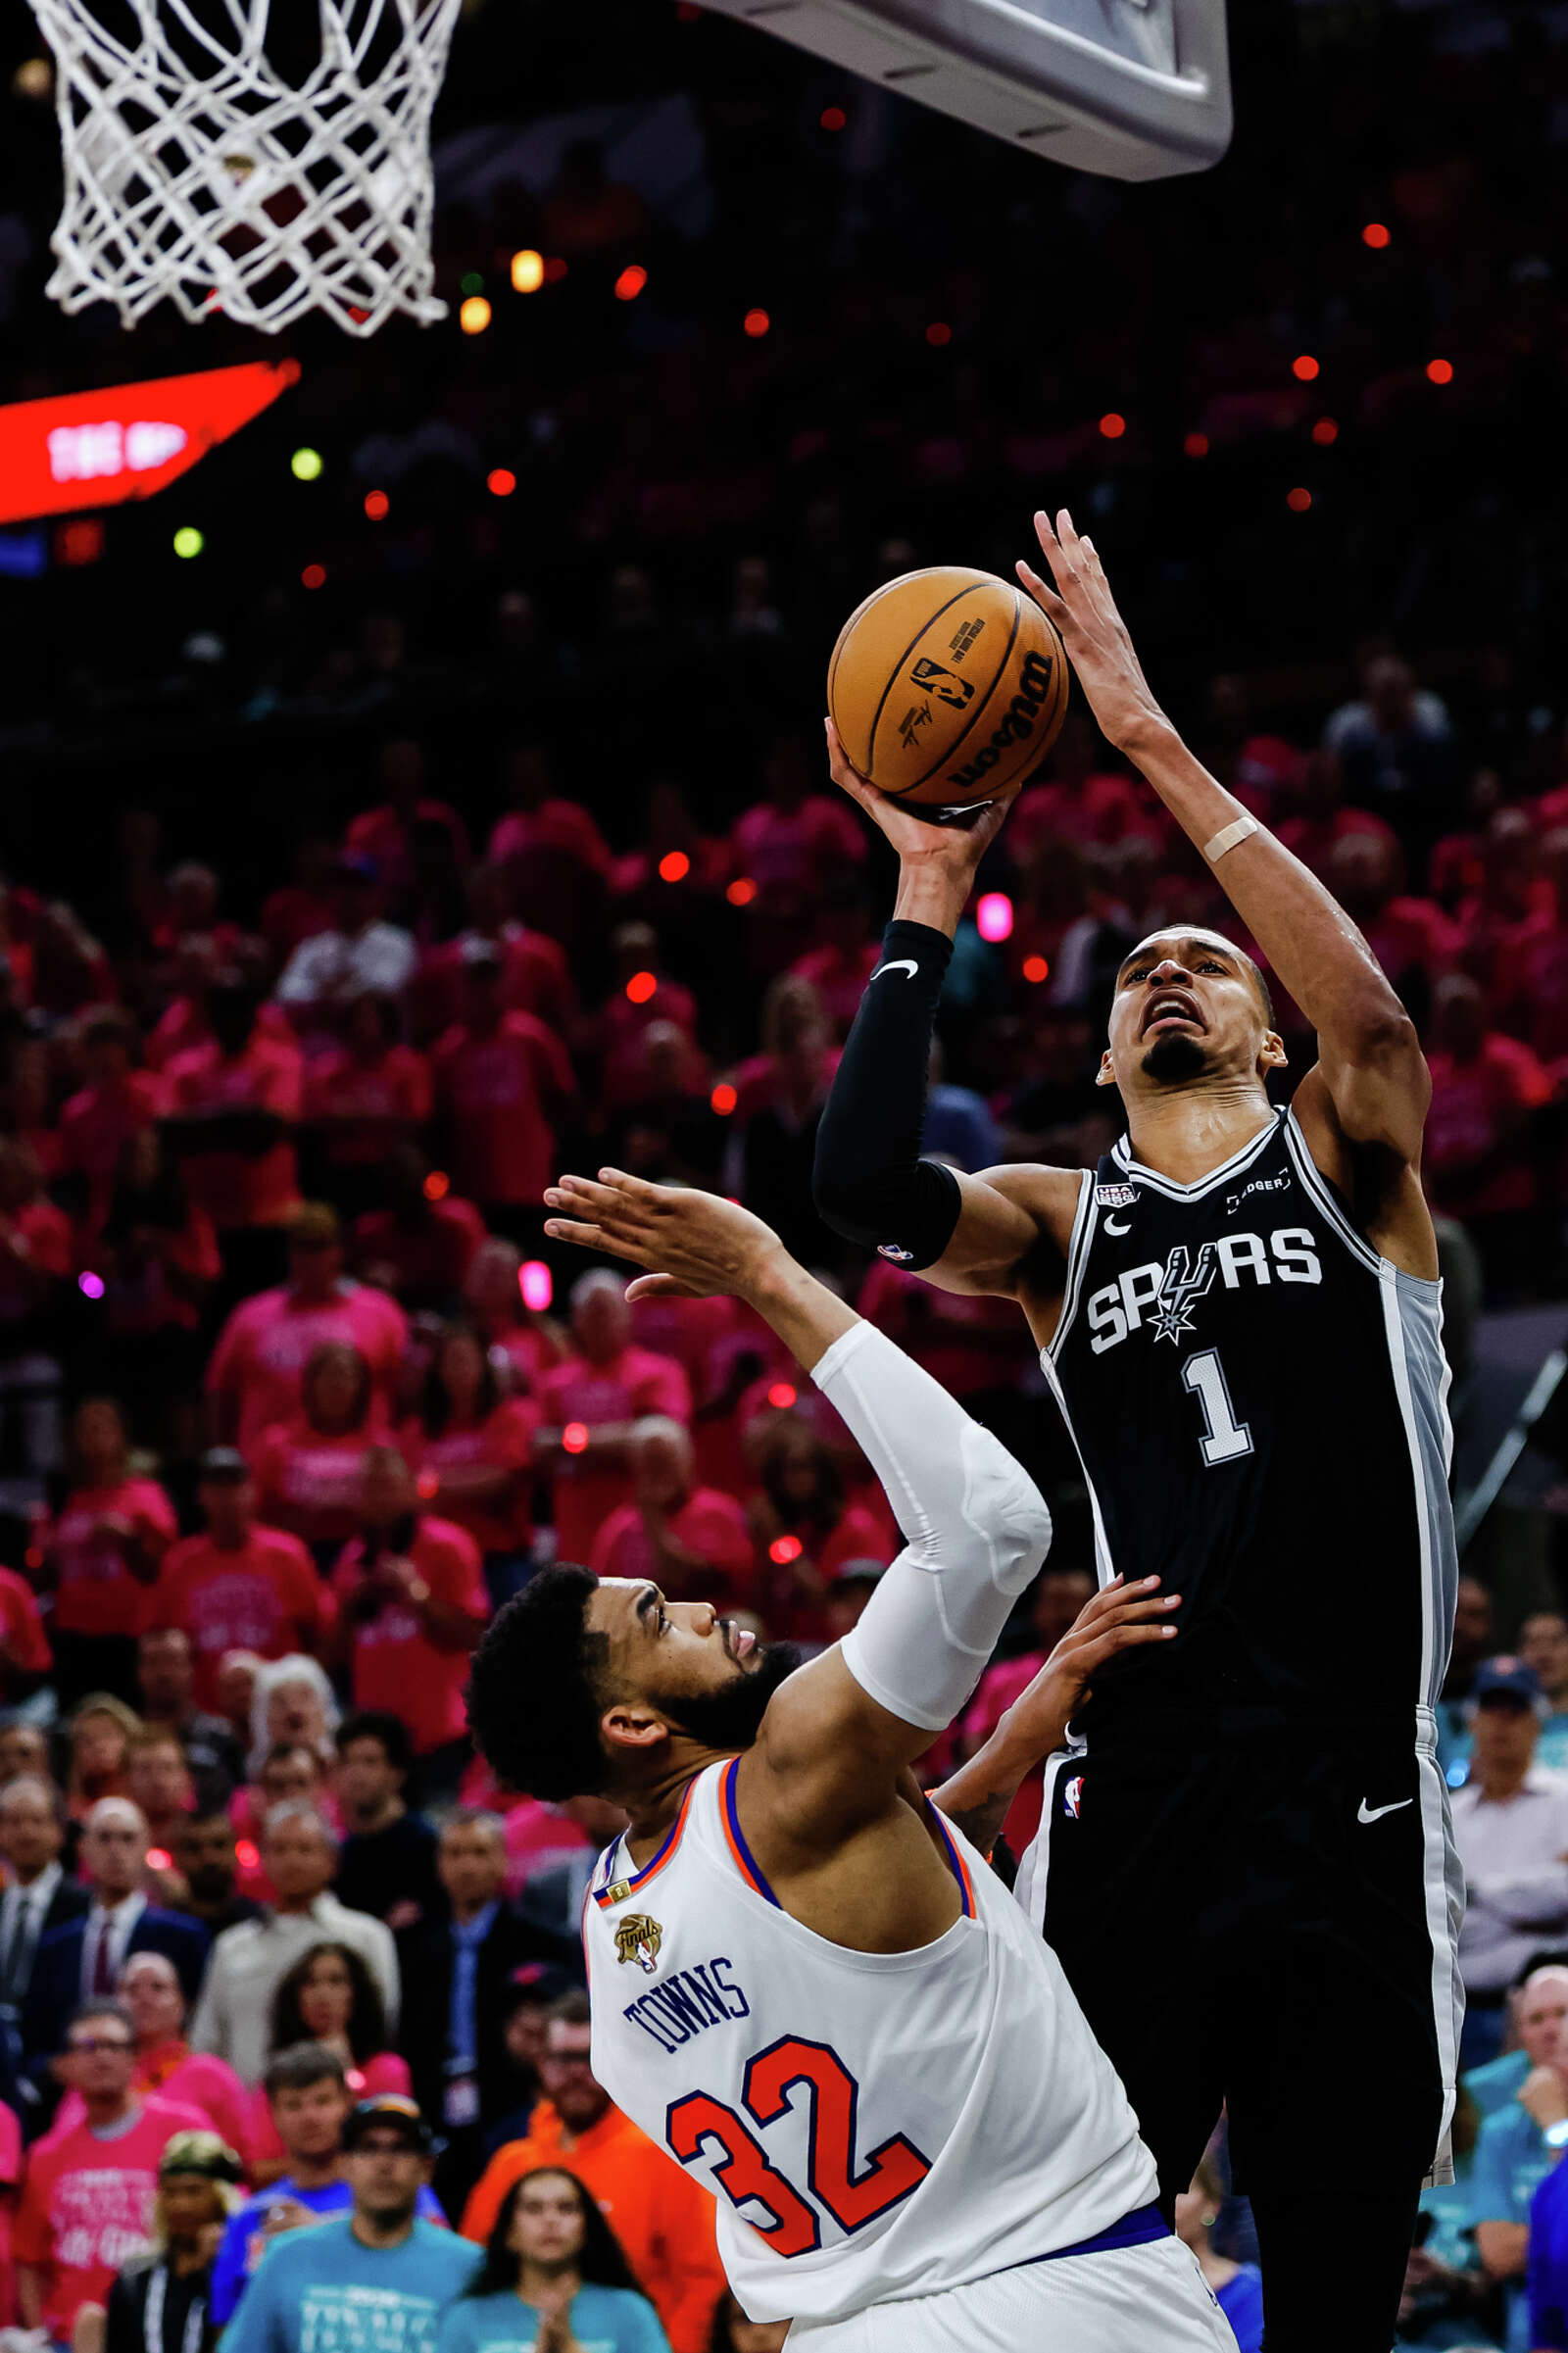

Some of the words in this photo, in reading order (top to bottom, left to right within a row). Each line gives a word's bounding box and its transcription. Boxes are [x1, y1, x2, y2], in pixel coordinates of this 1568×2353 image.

[1087, 1228, 1323, 1354] SPURS
[1180, 1347, 1255, 1467] 1
[615, 1919, 660, 1964] Finals
[623, 1957, 750, 2054] TOWNS
[665, 2034, 932, 2258] 32
